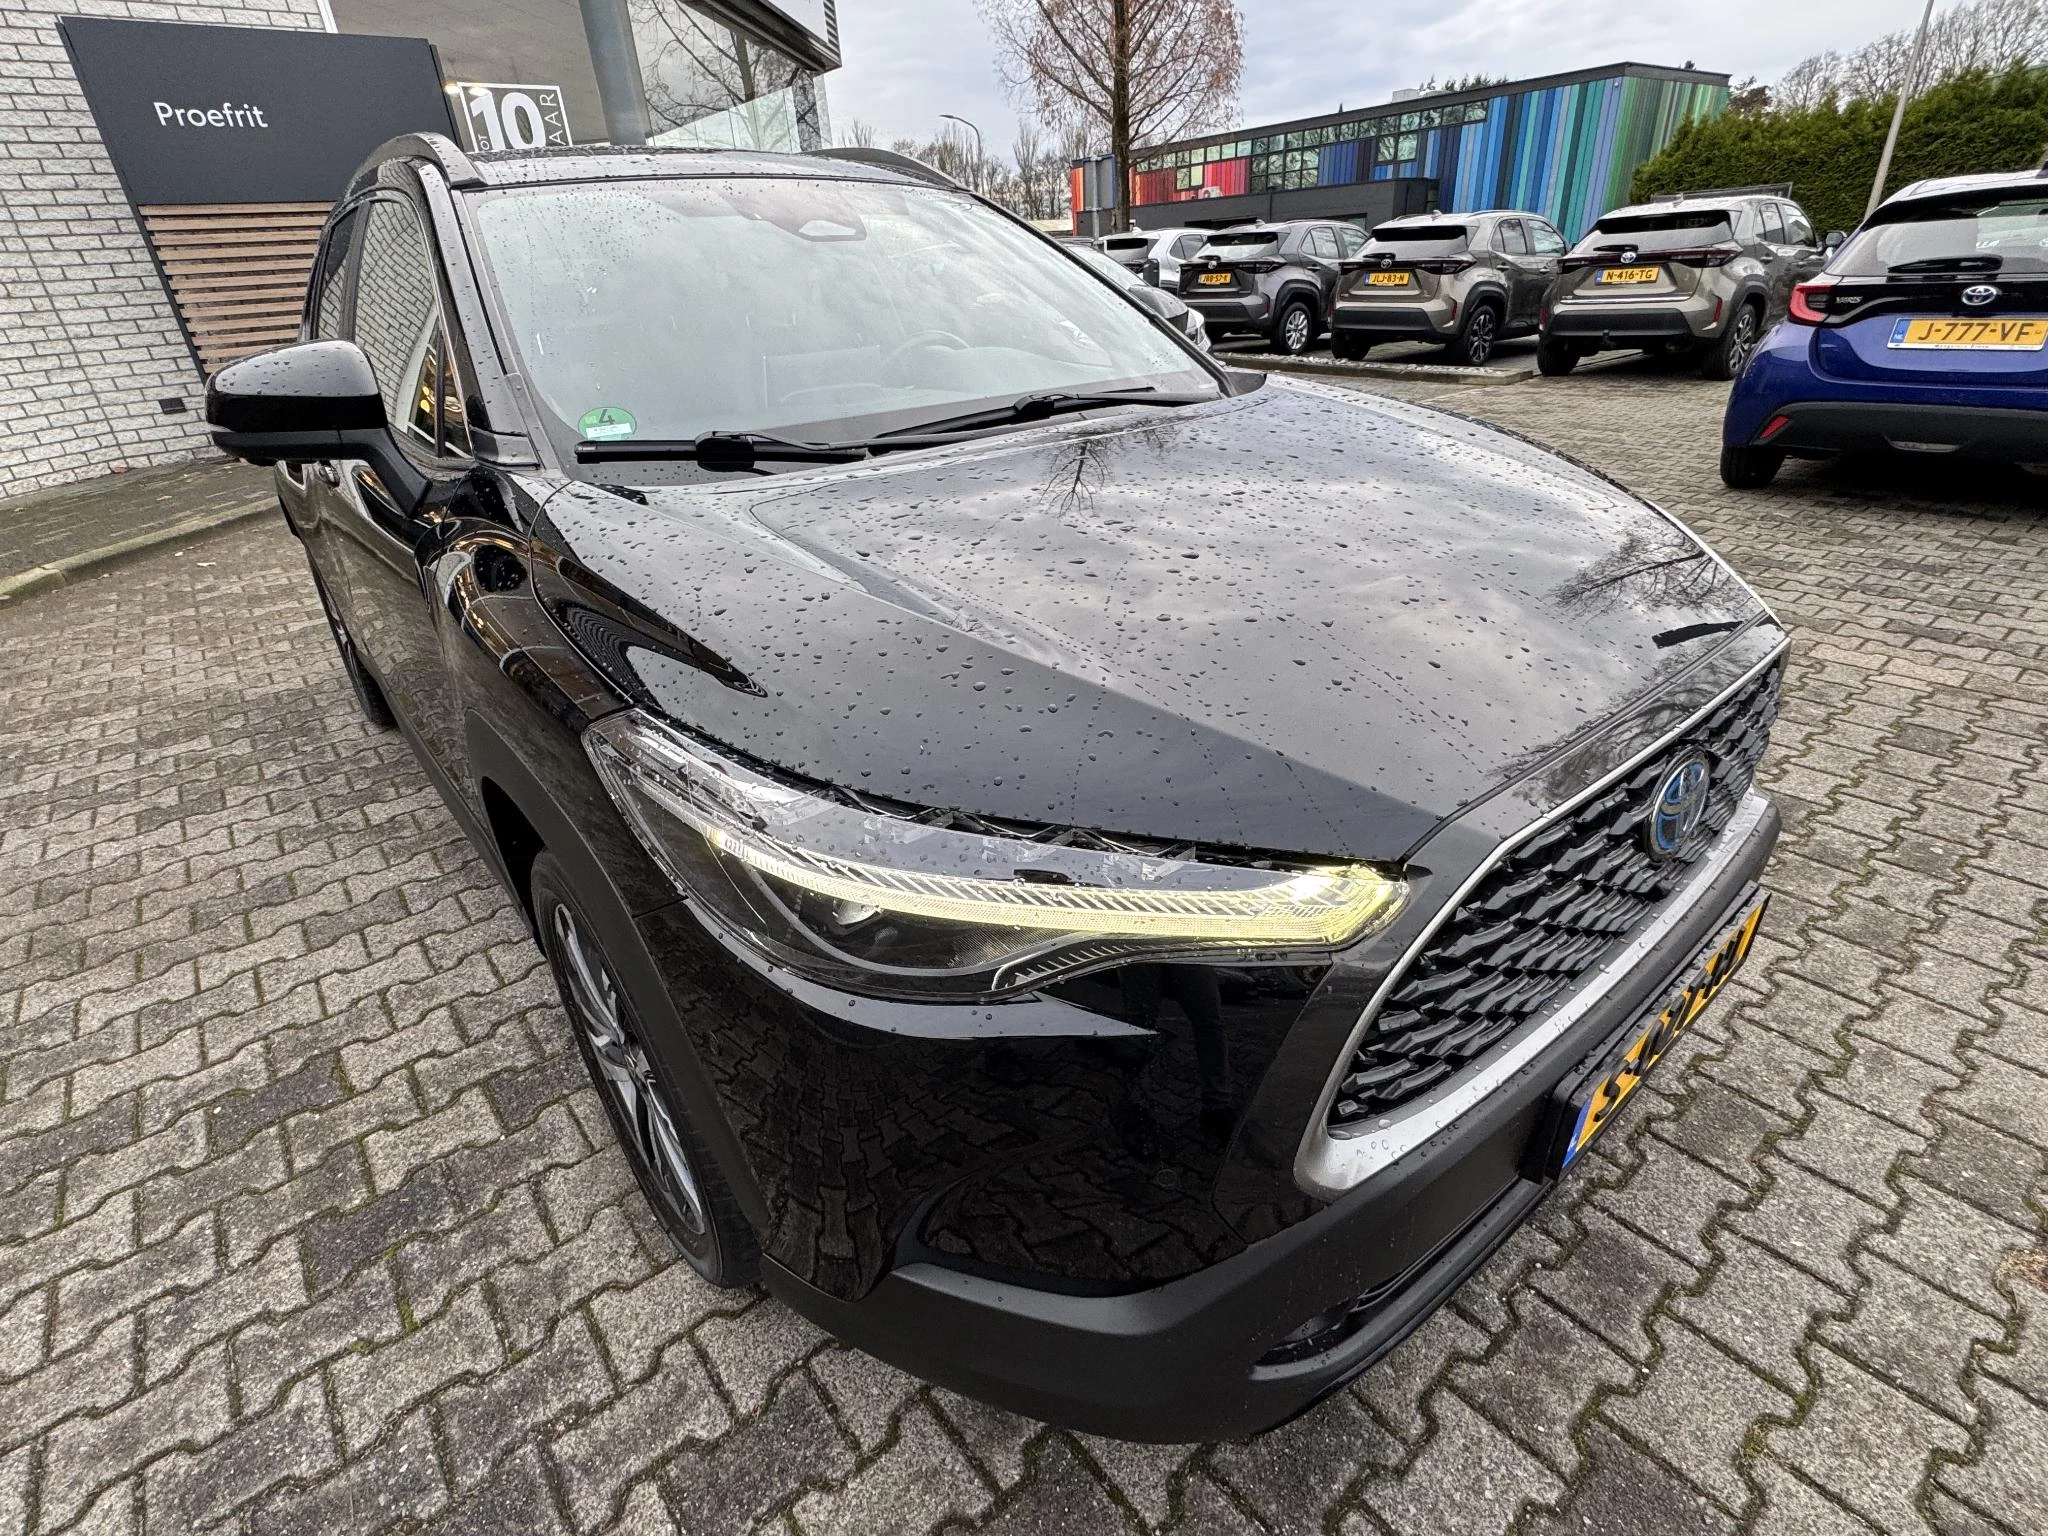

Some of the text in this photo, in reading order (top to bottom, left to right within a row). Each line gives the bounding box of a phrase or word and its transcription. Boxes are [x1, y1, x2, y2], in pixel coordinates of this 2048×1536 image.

[153, 101, 268, 128] Proefrit
[469, 90, 546, 149] 10
[540, 93, 566, 145] AAR
[1606, 269, 1653, 280] N-416-TG
[1918, 322, 2034, 341] J-777-VF
